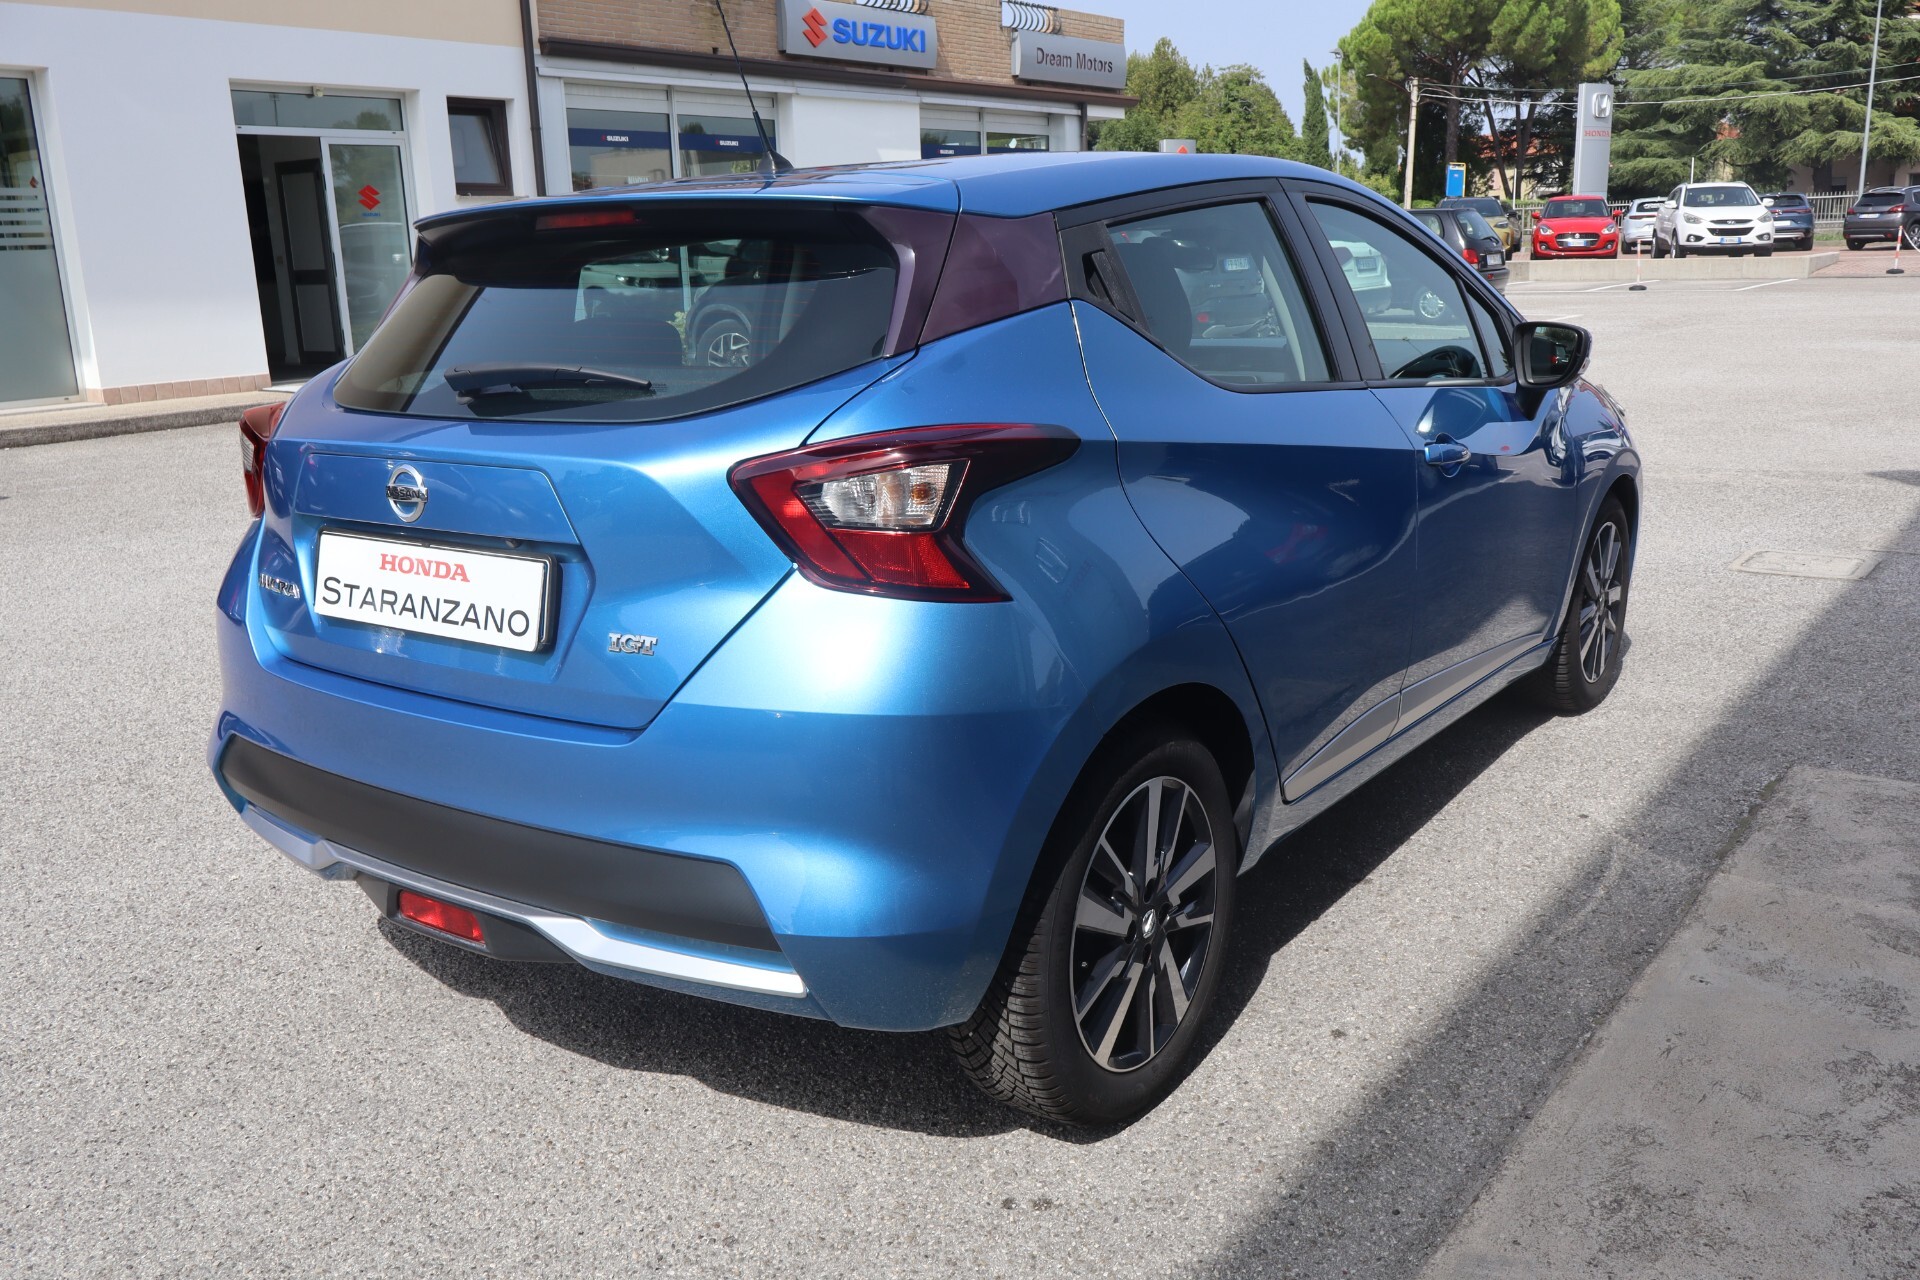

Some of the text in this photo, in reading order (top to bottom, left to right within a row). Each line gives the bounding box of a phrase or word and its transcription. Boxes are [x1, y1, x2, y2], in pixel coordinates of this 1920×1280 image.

[833, 18, 926, 53] SUZUKI
[1036, 47, 1113, 73] Dream Motors
[1584, 130, 1611, 138] HONDA
[379, 553, 471, 583] HONDA
[322, 576, 530, 637] STARANZANO
